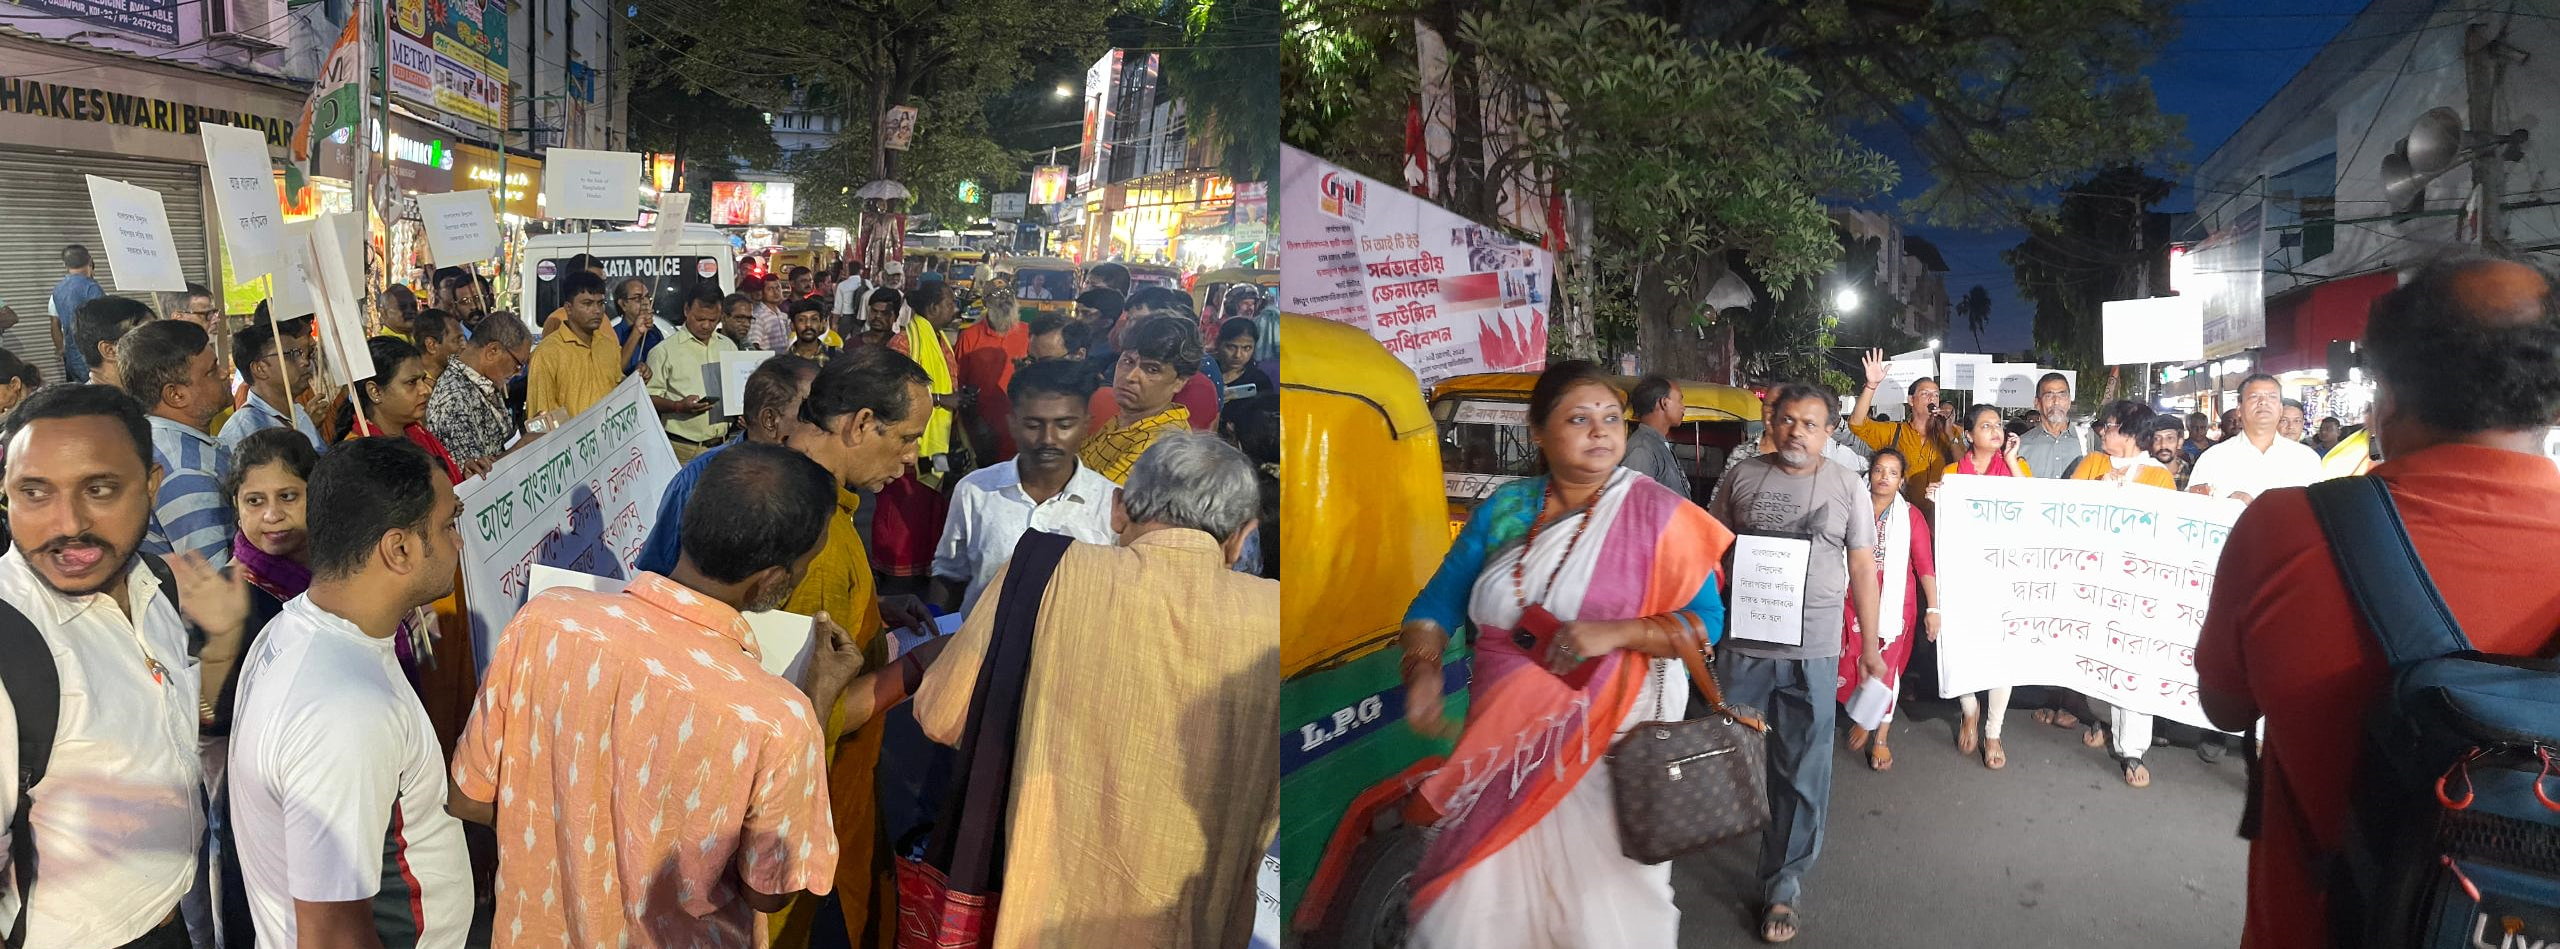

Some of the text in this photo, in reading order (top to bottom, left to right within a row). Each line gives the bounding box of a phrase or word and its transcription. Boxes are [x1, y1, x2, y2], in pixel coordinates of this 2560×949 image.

[393, 40, 432, 75] METRO
[635, 257, 680, 277] POLICE
[1372, 278, 1441, 304] জেনারেল
[476, 491, 514, 544] আজ
[519, 444, 576, 514] বাংলাদেশ
[576, 429, 601, 473] কাল
[1964, 498, 2025, 524] আজ
[2040, 502, 2160, 539] বাংলাদেশ
[1984, 546, 2104, 572] বাংলাদেশে
[2075, 654, 2143, 692] করতে
[1300, 694, 1384, 753] L.P.G
